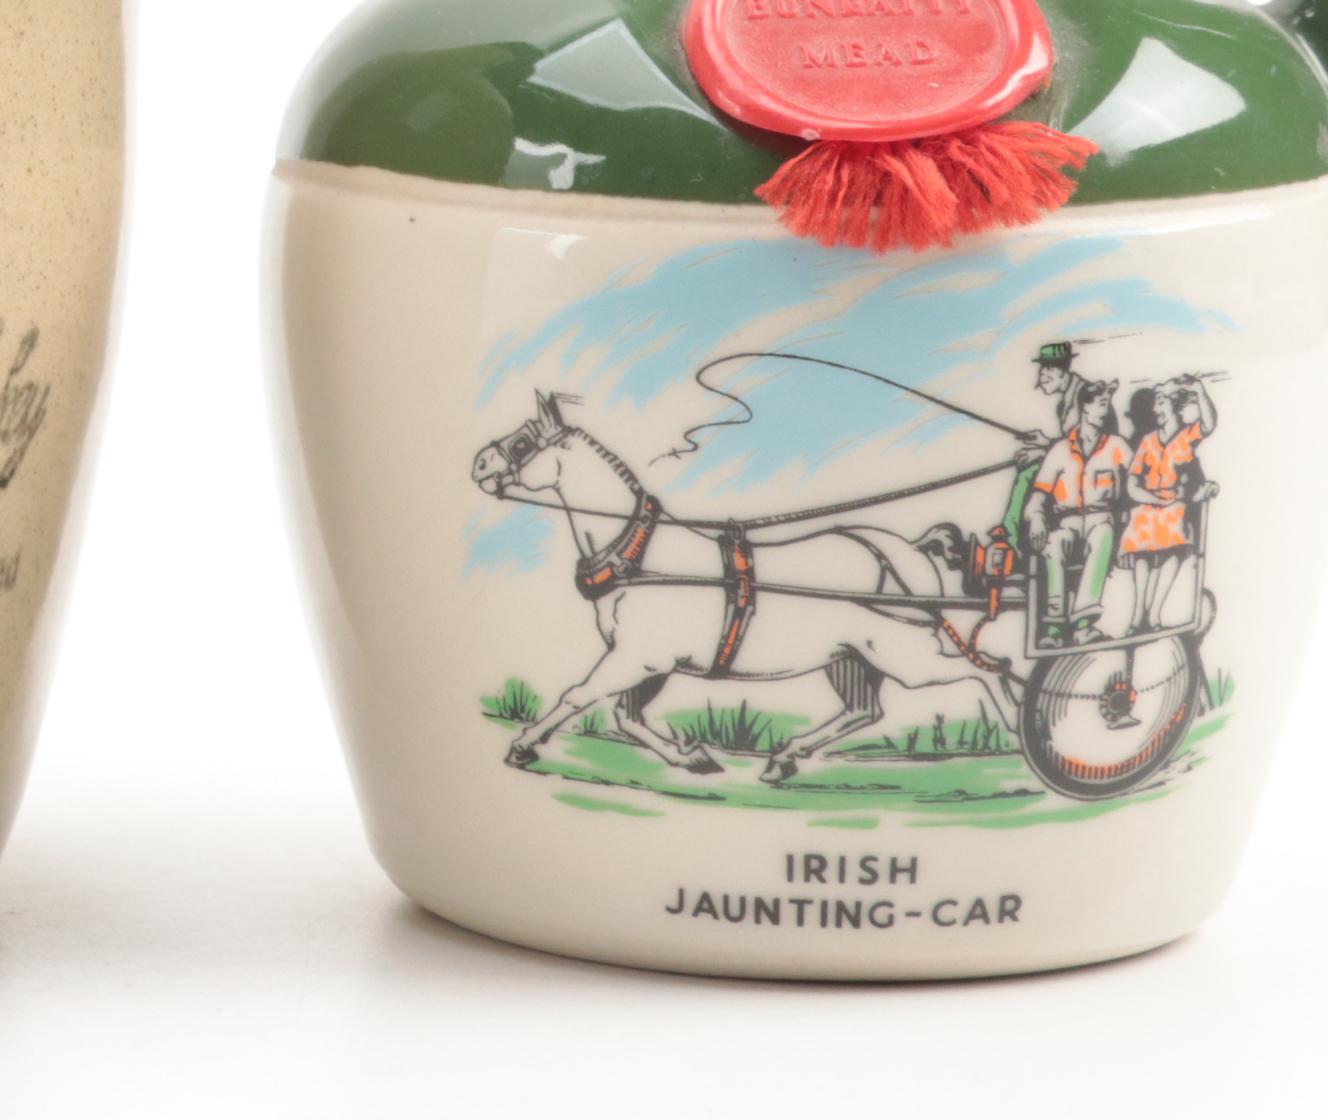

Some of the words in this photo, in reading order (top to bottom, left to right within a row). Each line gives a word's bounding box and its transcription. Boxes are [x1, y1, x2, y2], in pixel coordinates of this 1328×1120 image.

[799, 39, 938, 68] MEAD
[784, 852, 920, 886] IRISH
[665, 887, 1024, 930] JAUNTING-CAR
